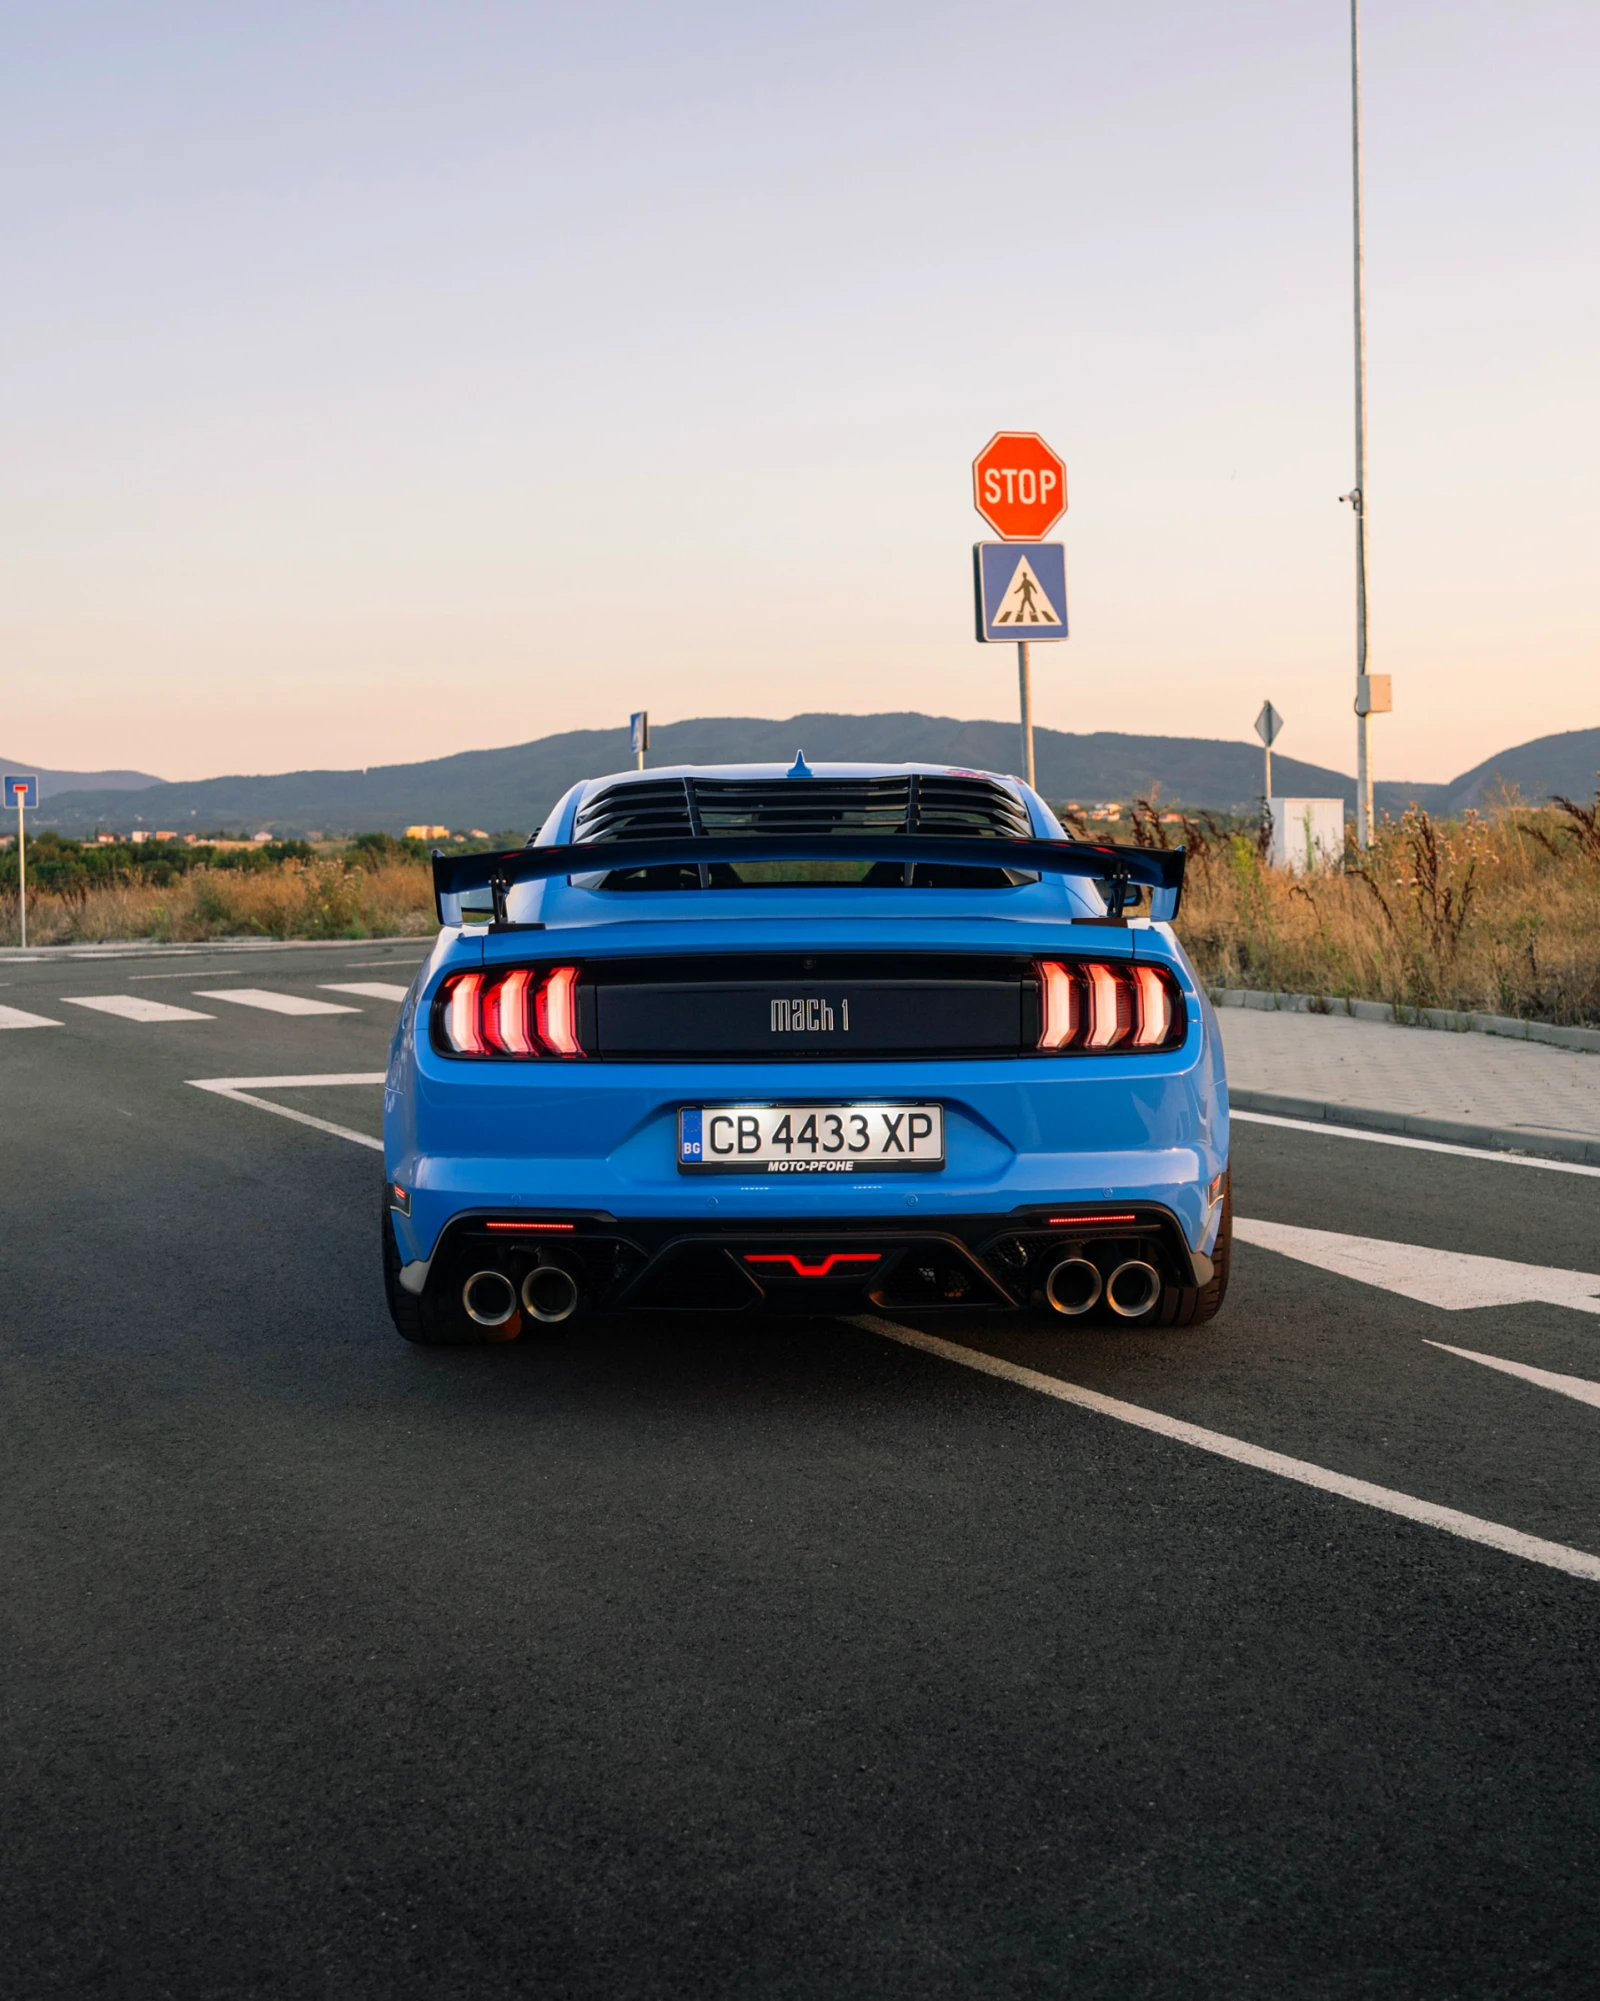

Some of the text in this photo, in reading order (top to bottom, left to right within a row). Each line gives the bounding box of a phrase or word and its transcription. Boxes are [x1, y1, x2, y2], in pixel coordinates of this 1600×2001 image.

[984, 467, 1057, 505] STOP
[841, 998, 849, 1031] 1
[683, 1142, 701, 1155] BG
[710, 1113, 933, 1154] CB 4433 XP
[767, 1161, 854, 1172] MOTO-PFOHE
